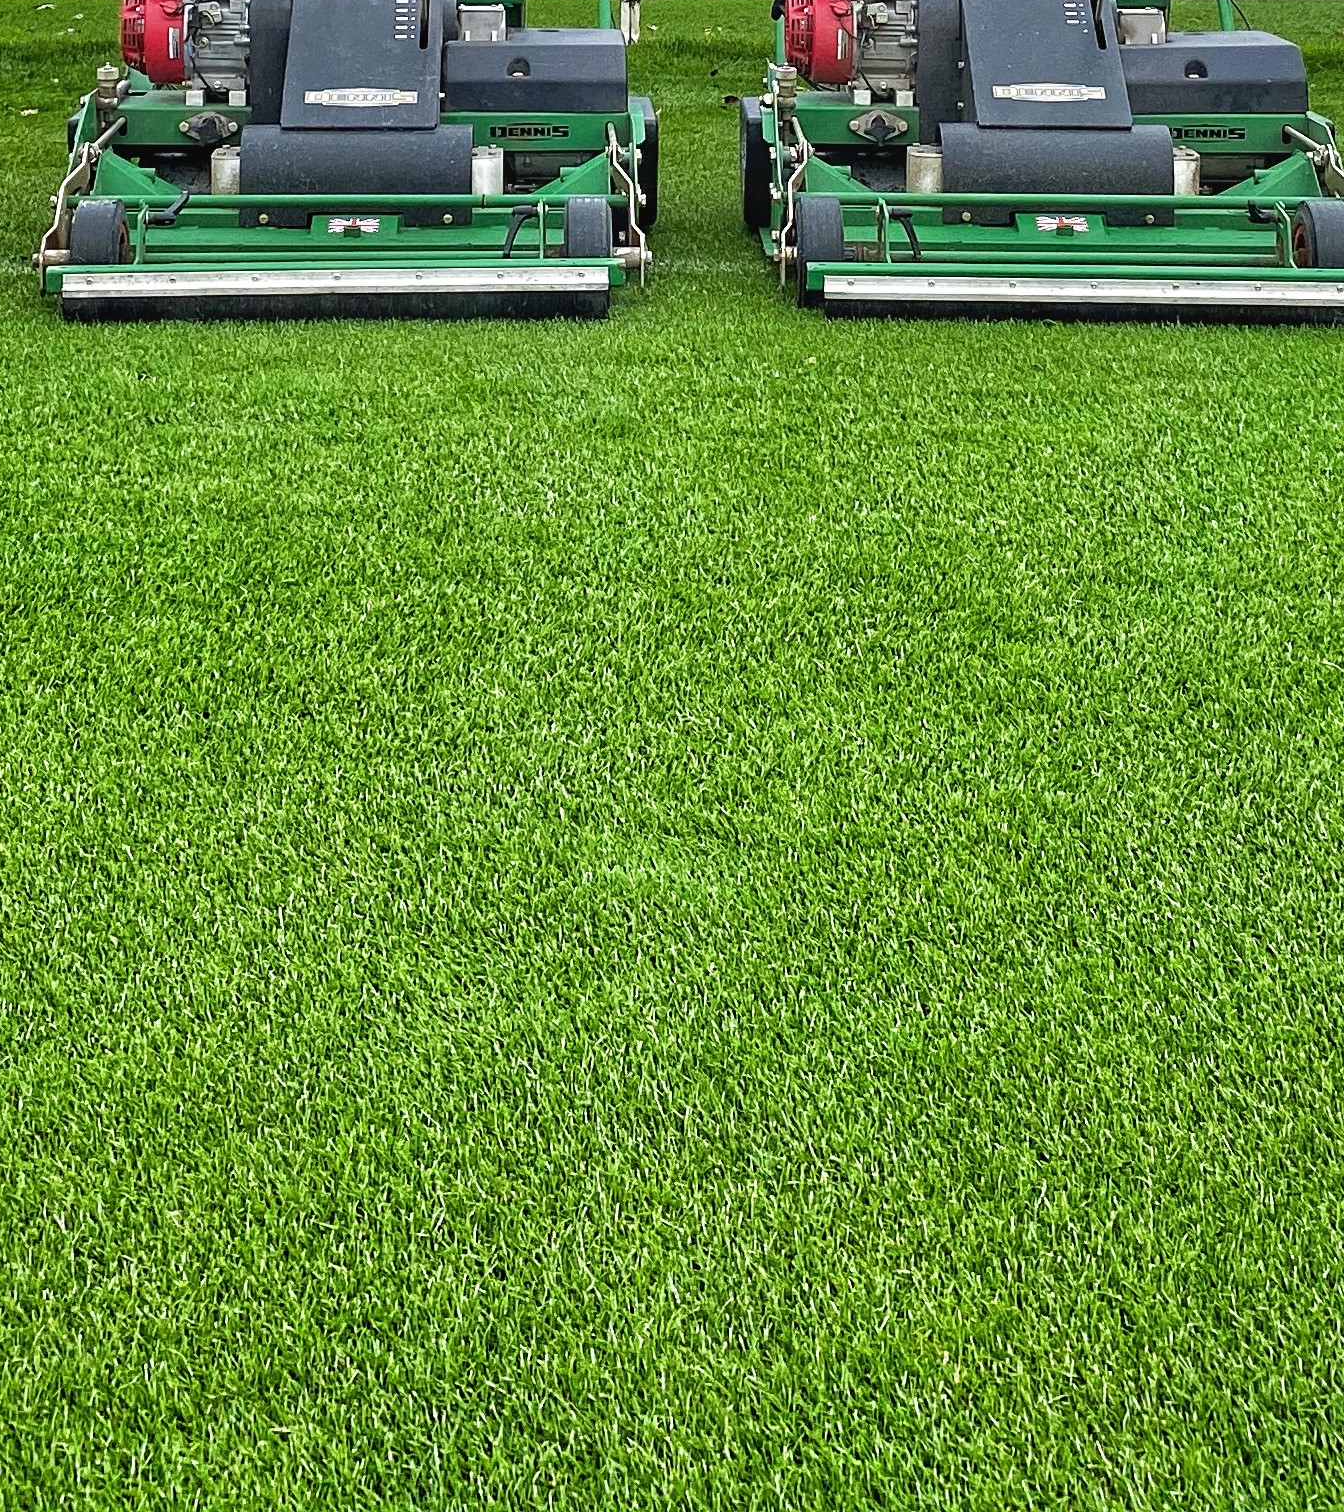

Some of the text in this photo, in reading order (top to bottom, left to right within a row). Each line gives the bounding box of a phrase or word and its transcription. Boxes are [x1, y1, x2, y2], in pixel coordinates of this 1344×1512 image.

[305, 89, 418, 106] DENNIS
[994, 84, 1106, 101] DENNIS
[489, 125, 570, 138] DENNIS
[1168, 127, 1246, 140] DENNIS
